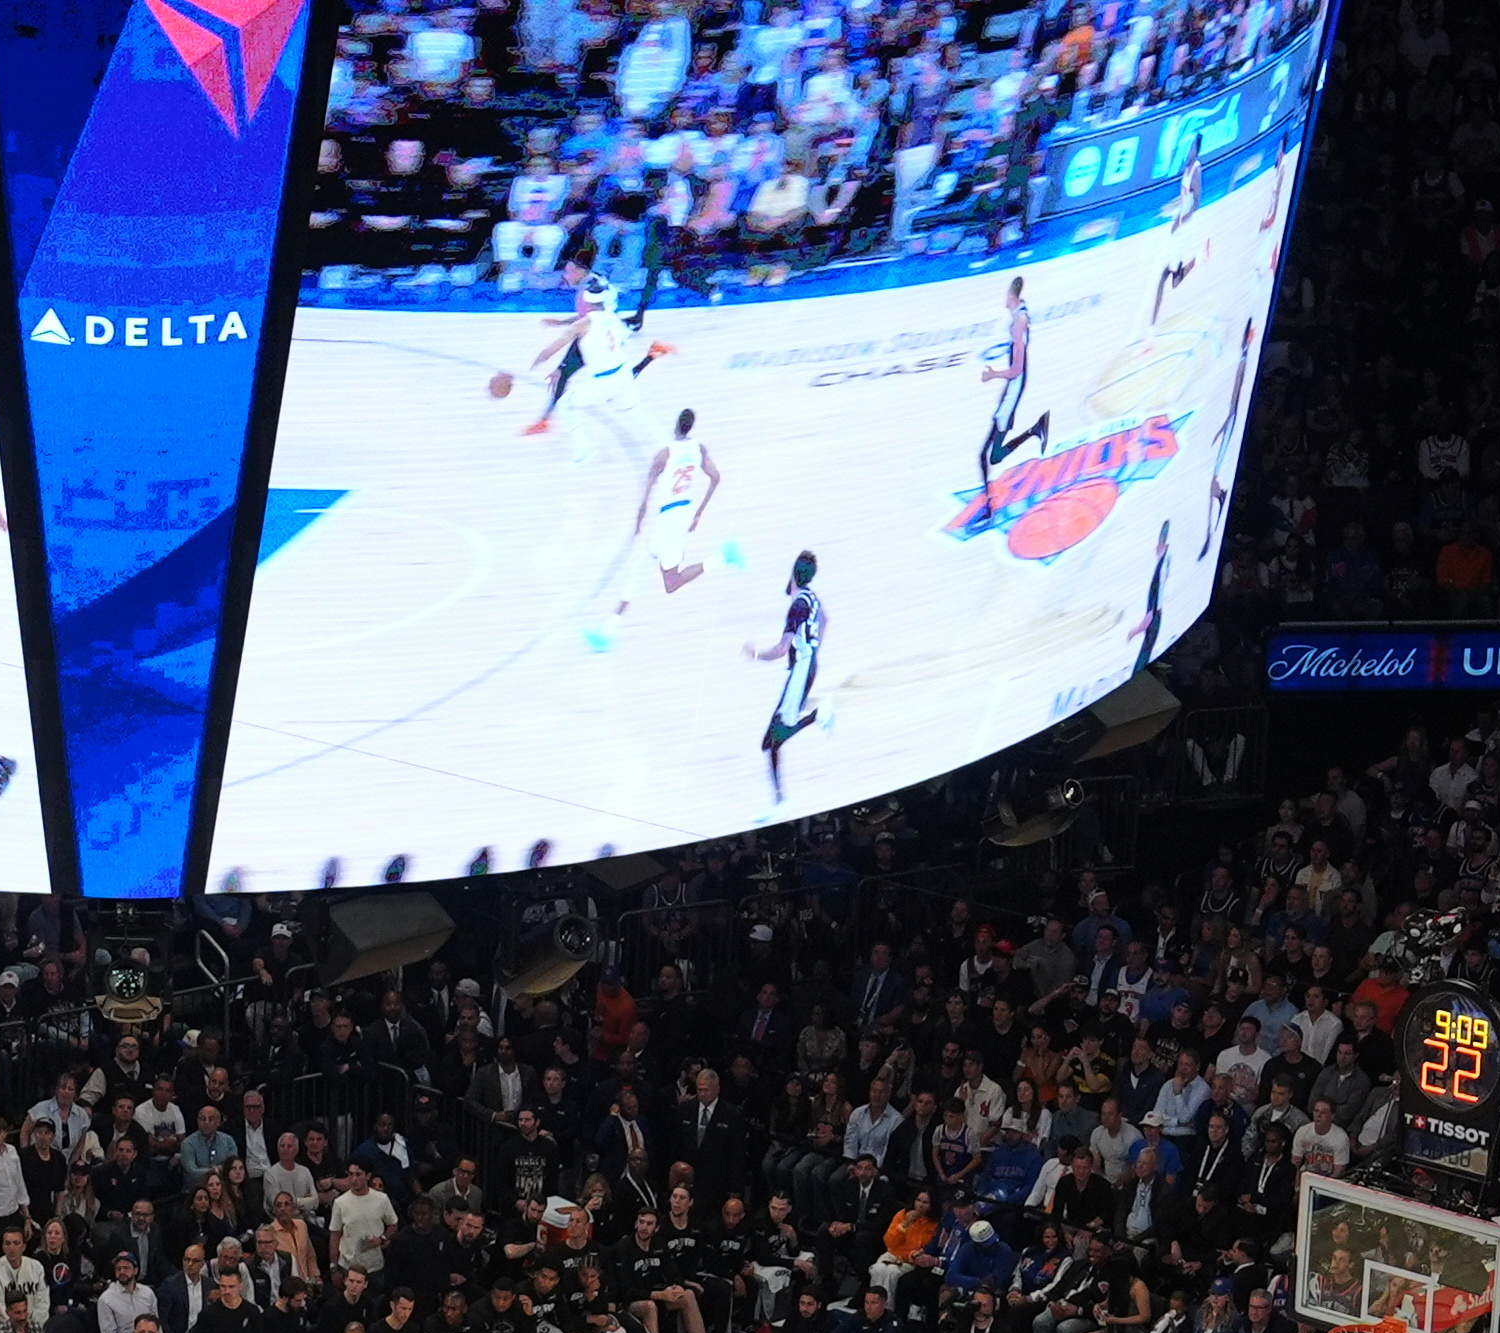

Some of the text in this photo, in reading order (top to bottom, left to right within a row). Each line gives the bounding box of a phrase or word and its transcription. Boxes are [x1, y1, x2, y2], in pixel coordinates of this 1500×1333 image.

[85, 311, 248, 348] DELTA
[1268, 644, 1418, 682] Michelob
[1435, 1010, 1489, 1047] 9:09
[1420, 1037, 1483, 1104] 22
[1426, 1116, 1490, 1146] TISSOT
